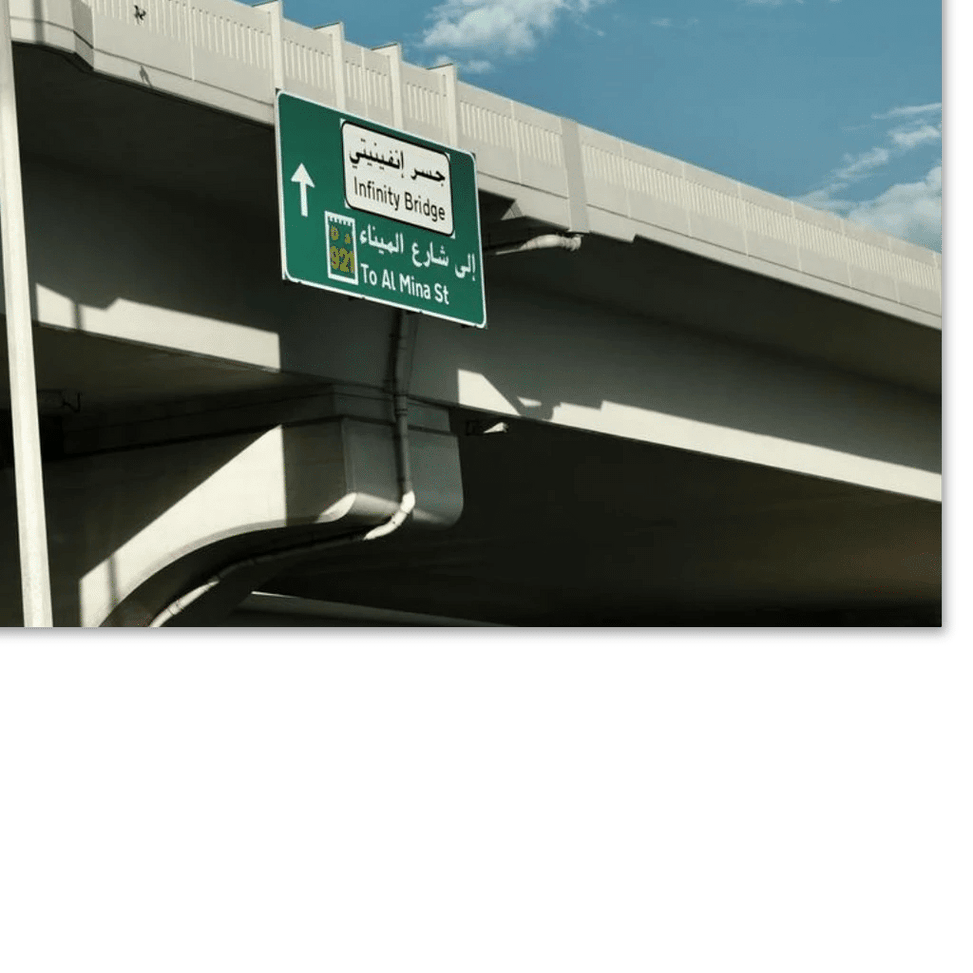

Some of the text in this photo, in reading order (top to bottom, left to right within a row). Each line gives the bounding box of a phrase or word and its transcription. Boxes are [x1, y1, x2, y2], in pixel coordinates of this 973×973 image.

[349, 138, 446, 187] جسر إنفينيتي
[353, 176, 446, 223] Infinity Bridge
[359, 224, 476, 281] إلى شارع الميناء
[360, 262, 449, 305] To Al Mina St
